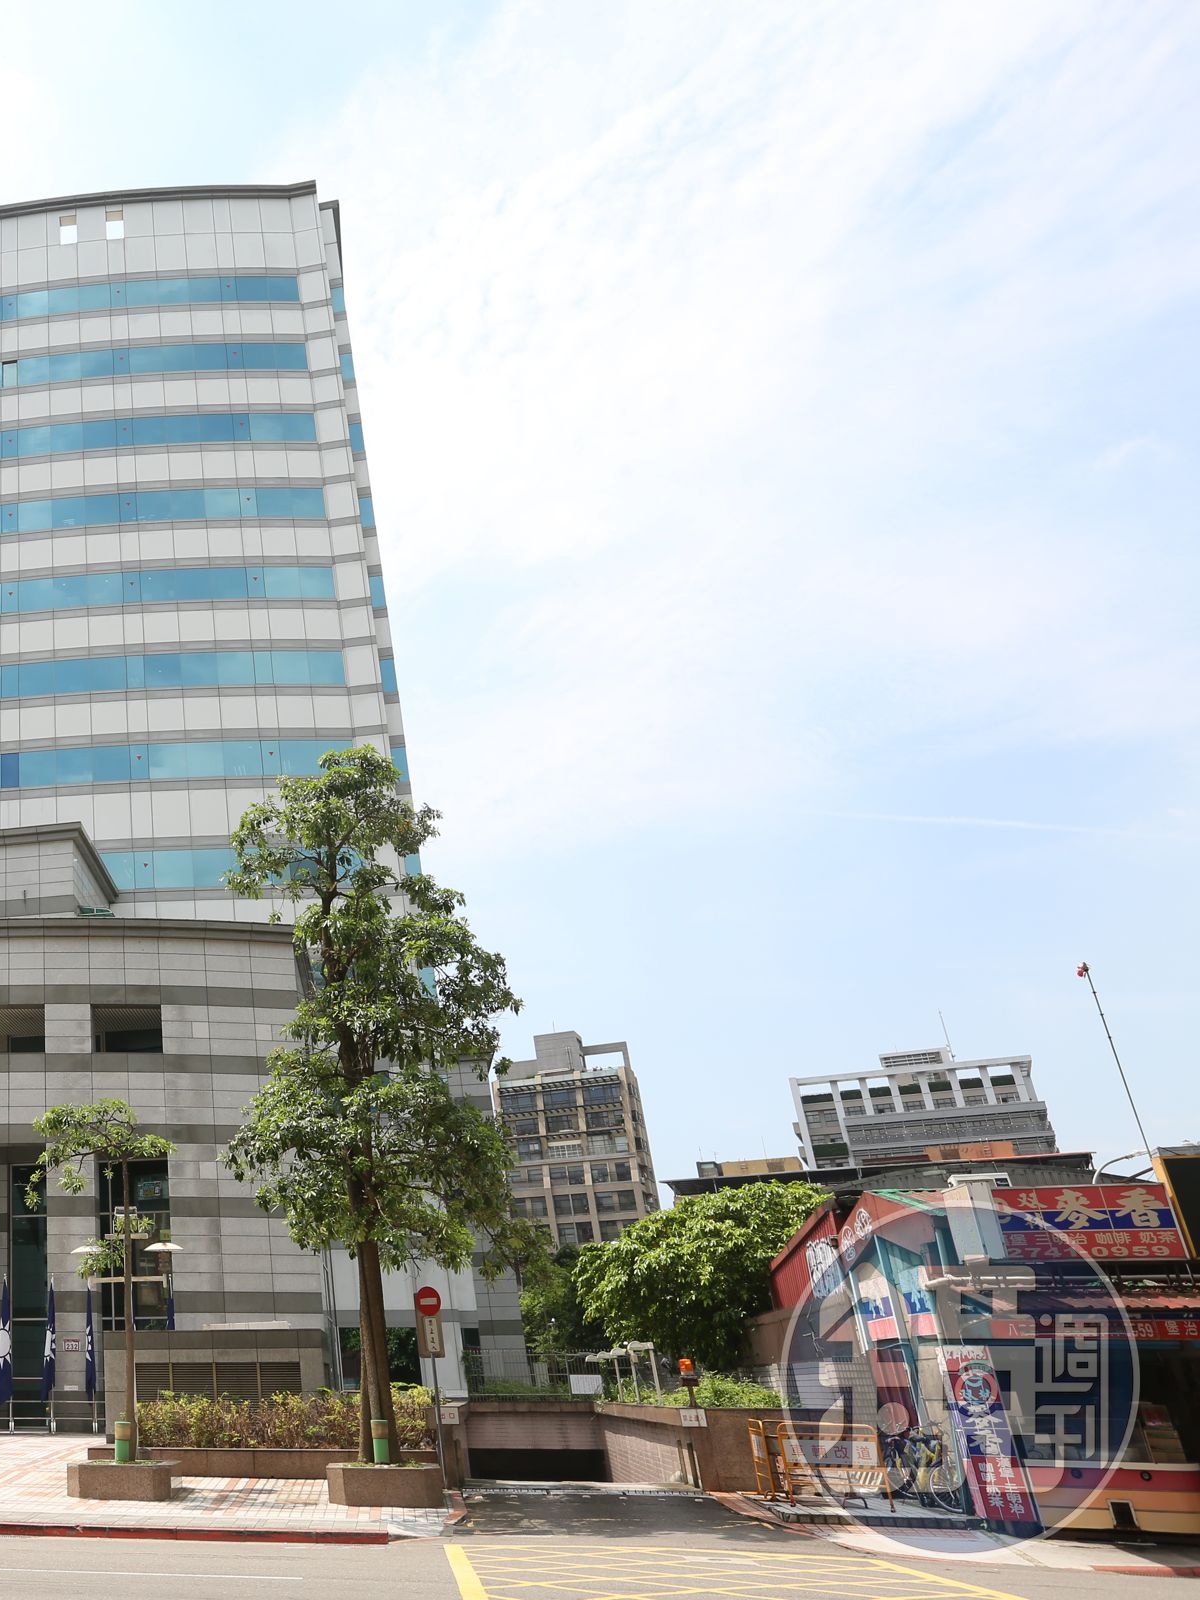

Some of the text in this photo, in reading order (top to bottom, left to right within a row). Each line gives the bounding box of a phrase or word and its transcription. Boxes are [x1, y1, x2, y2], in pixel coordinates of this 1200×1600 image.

[1095, 1231, 1132, 1245] 咖啡
[1139, 1230, 1177, 1244] 奶茶
[790, 1444, 872, 1461] 車輛改道
